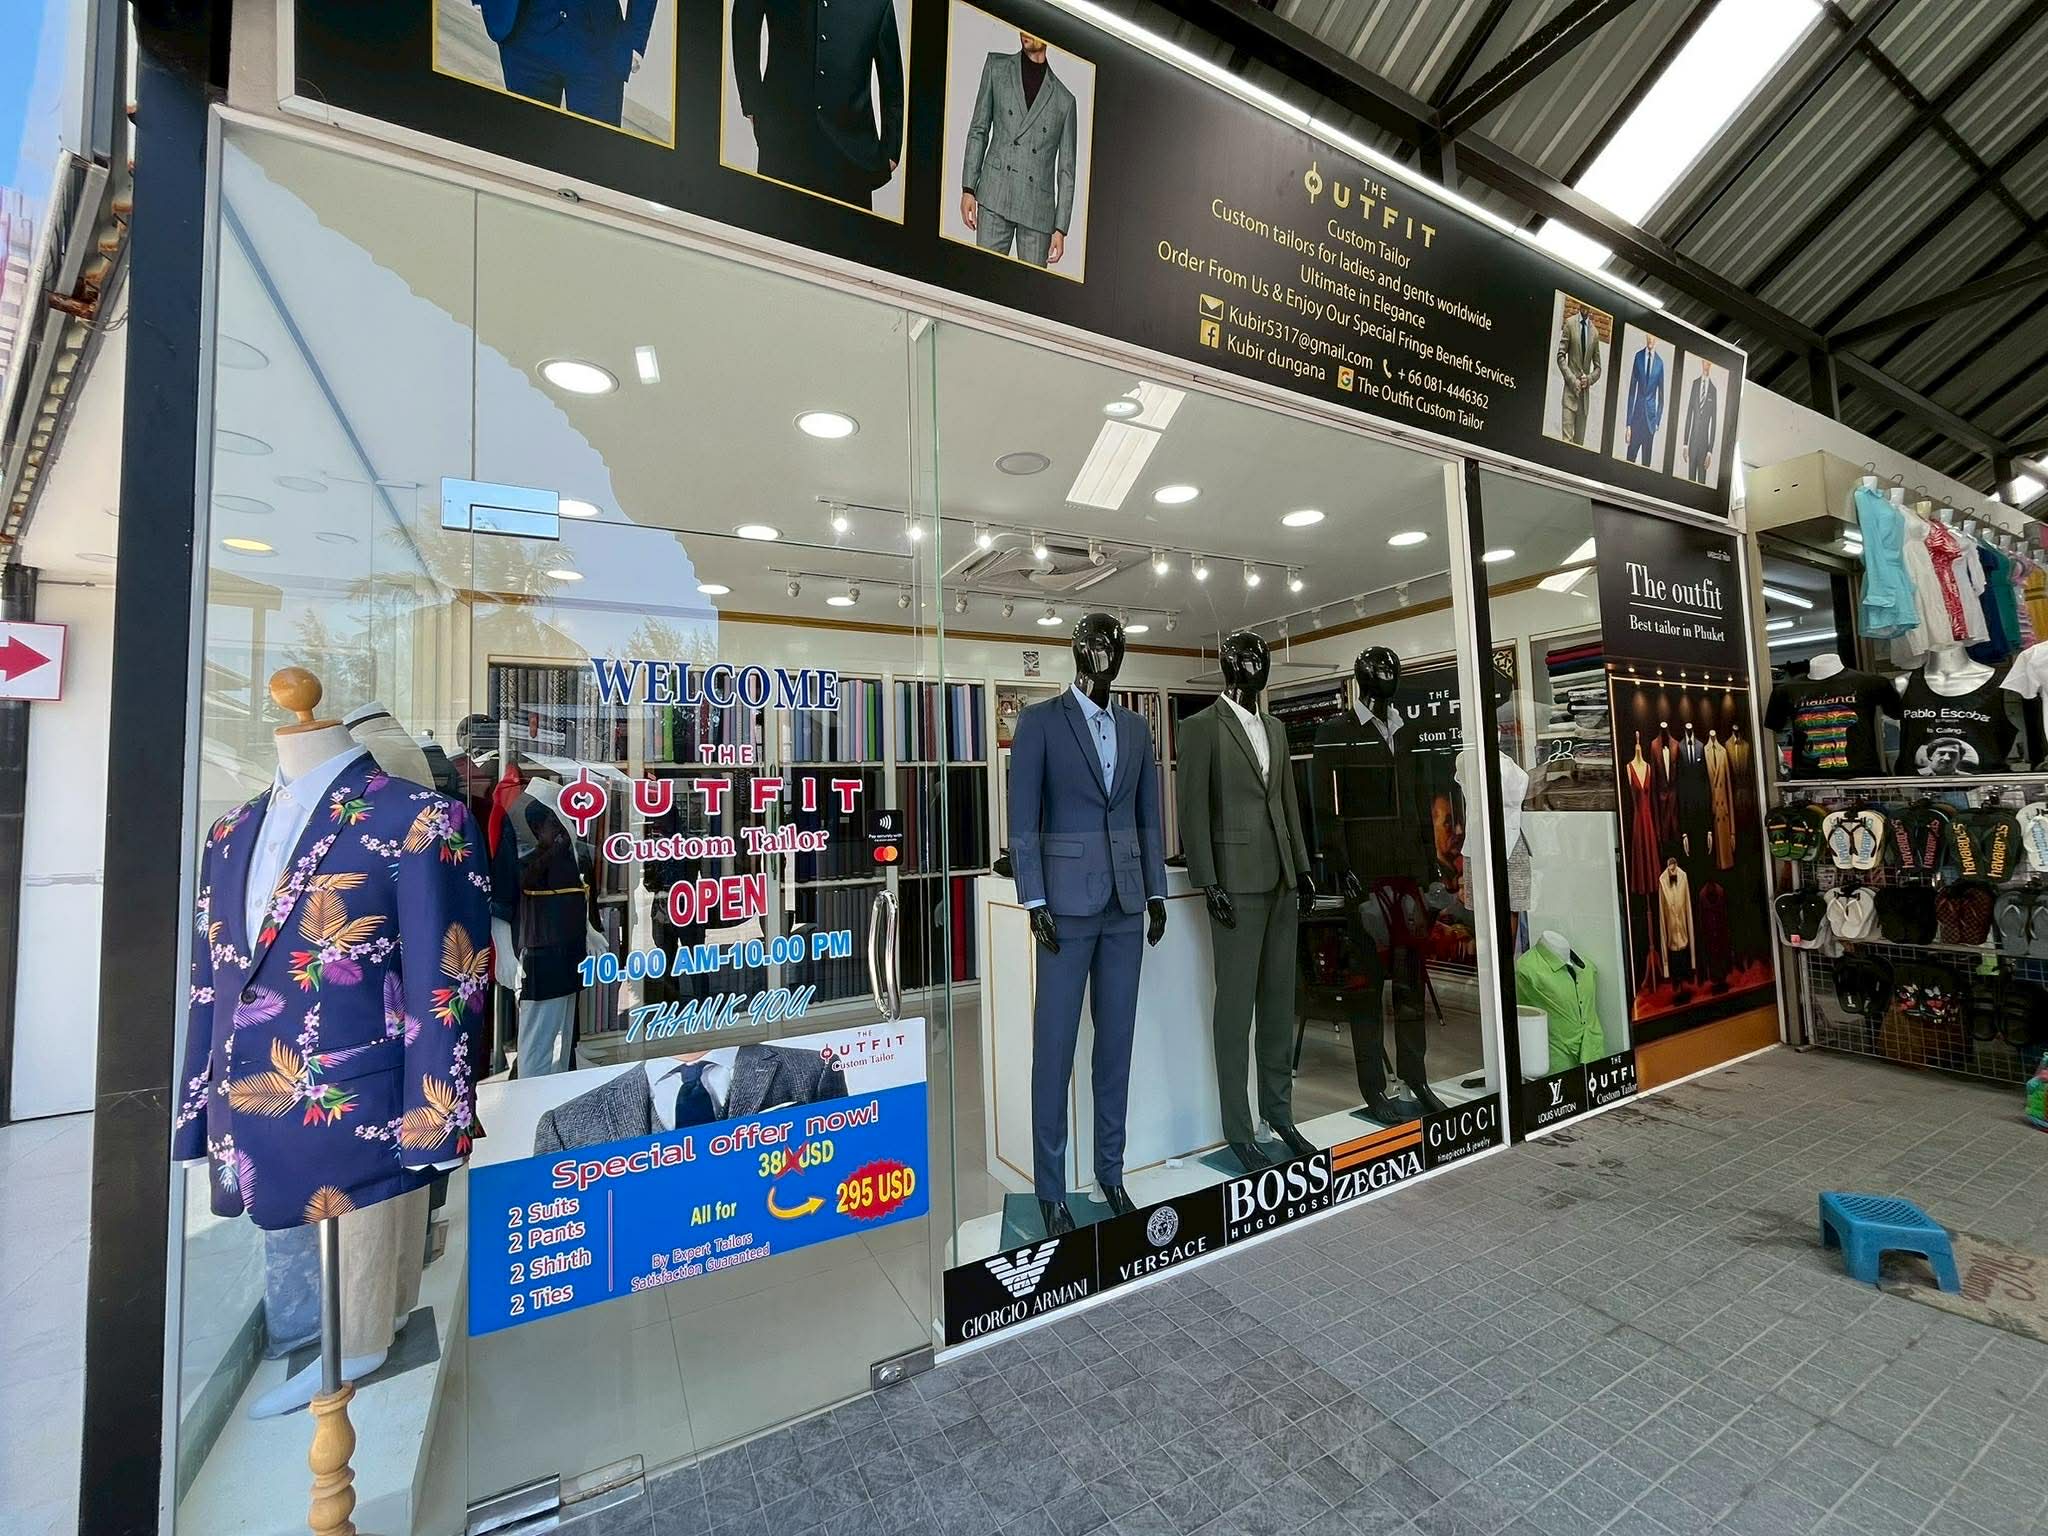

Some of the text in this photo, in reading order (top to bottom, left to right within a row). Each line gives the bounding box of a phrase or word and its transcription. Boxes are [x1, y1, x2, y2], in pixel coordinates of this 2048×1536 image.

[1304, 161, 1436, 248] OUTFIT
[1363, 178, 1387, 200] THE
[1211, 198, 1492, 331] Custom tailors for ladies and gents worldwide
[1327, 219, 1411, 269] Custom Tailor
[1158, 240, 1517, 390] Order From Us & Enjoy Our Special Fringe Benefit Services.
[1300, 264, 1426, 329] Ultimate in Elegance
[1227, 333, 1326, 381] Kubir dungana
[1229, 305, 1490, 410] Kubir5317@gmail.com + 66 081-4446362
[1357, 375, 1484, 431] The Outfit Custom Tailor
[1625, 562, 1723, 610] The outfit
[1629, 614, 1726, 642] Best tailor in Phuket
[591, 657, 840, 711] WELCOME
[1428, 690, 1450, 700] THE
[1903, 708, 1991, 723] Pablo Escobar
[699, 744, 754, 766] THE
[559, 766, 863, 838] OUTFIT
[603, 823, 830, 863] Custom Tailor
[668, 873, 769, 926] OPEN
[577, 930, 852, 987] 10.00 AM-10.00 PM
[626, 985, 817, 1043] THANK YOU
[857, 1030, 873, 1038] THE
[820, 1035, 905, 1064] OUTFIT
[832, 1053, 894, 1072] Custom Tailor
[1610, 1055, 1622, 1065] THE
[1537, 1102, 1577, 1124] LOUIS VUITTON
[1597, 1082, 1639, 1105] Custom Tailor
[552, 1099, 879, 1191] Special offer now!
[1429, 1104, 1496, 1147] GUCCI
[1437, 1136, 1490, 1163] timepieces & jewelry
[836, 1167, 916, 1214] 295 USD
[1228, 1154, 1329, 1223] BOSS
[1333, 1151, 1424, 1203] ZEGNA
[508, 1198, 580, 1228] 2 Suits
[690, 1201, 737, 1227] All for
[1231, 1195, 1329, 1239] HUGO BOSS
[508, 1220, 585, 1254] 2 Pants
[652, 1232, 753, 1269] By Expert Tailors
[1119, 1236, 1208, 1281] VERSACE
[510, 1247, 592, 1284] 2 Shirth
[630, 1241, 771, 1293] Satisfaction Guaranteed
[510, 1284, 573, 1315] 2 Ties
[961, 1278, 1088, 1339] GIORGIO ARMANI
